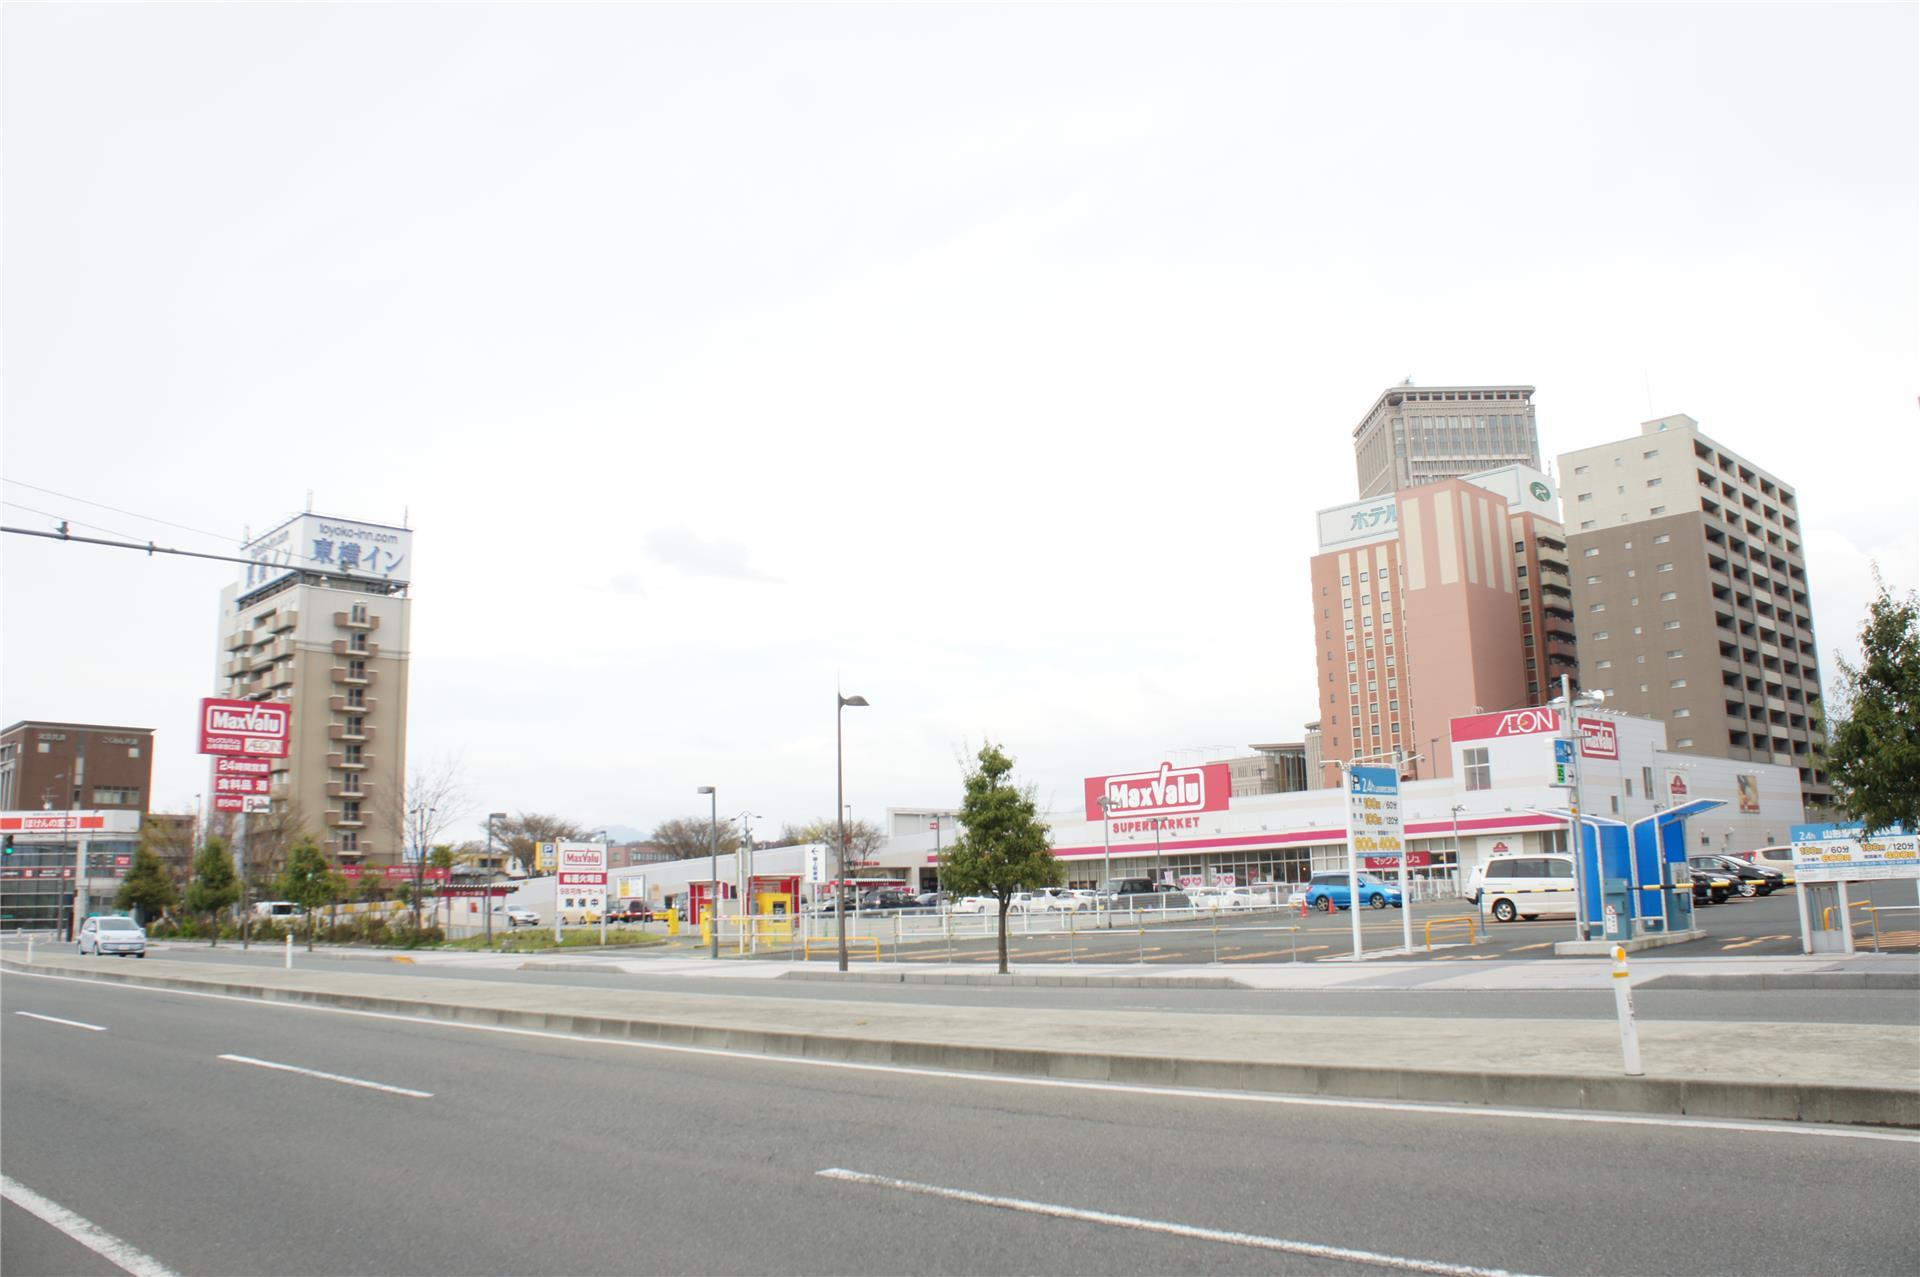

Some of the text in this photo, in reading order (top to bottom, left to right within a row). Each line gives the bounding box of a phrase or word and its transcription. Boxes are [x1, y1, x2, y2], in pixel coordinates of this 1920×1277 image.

[1350, 504, 1397, 531] ホテル
[318, 523, 399, 544] toyoko-inn.com
[310, 538, 405, 572] 東横イン
[213, 705, 279, 732] MaxValu
[218, 778, 253, 790] 食料品
[1110, 765, 1199, 808] MaxValu
[566, 848, 599, 863] MaxValu
[1373, 855, 1421, 865] マックスリュ
